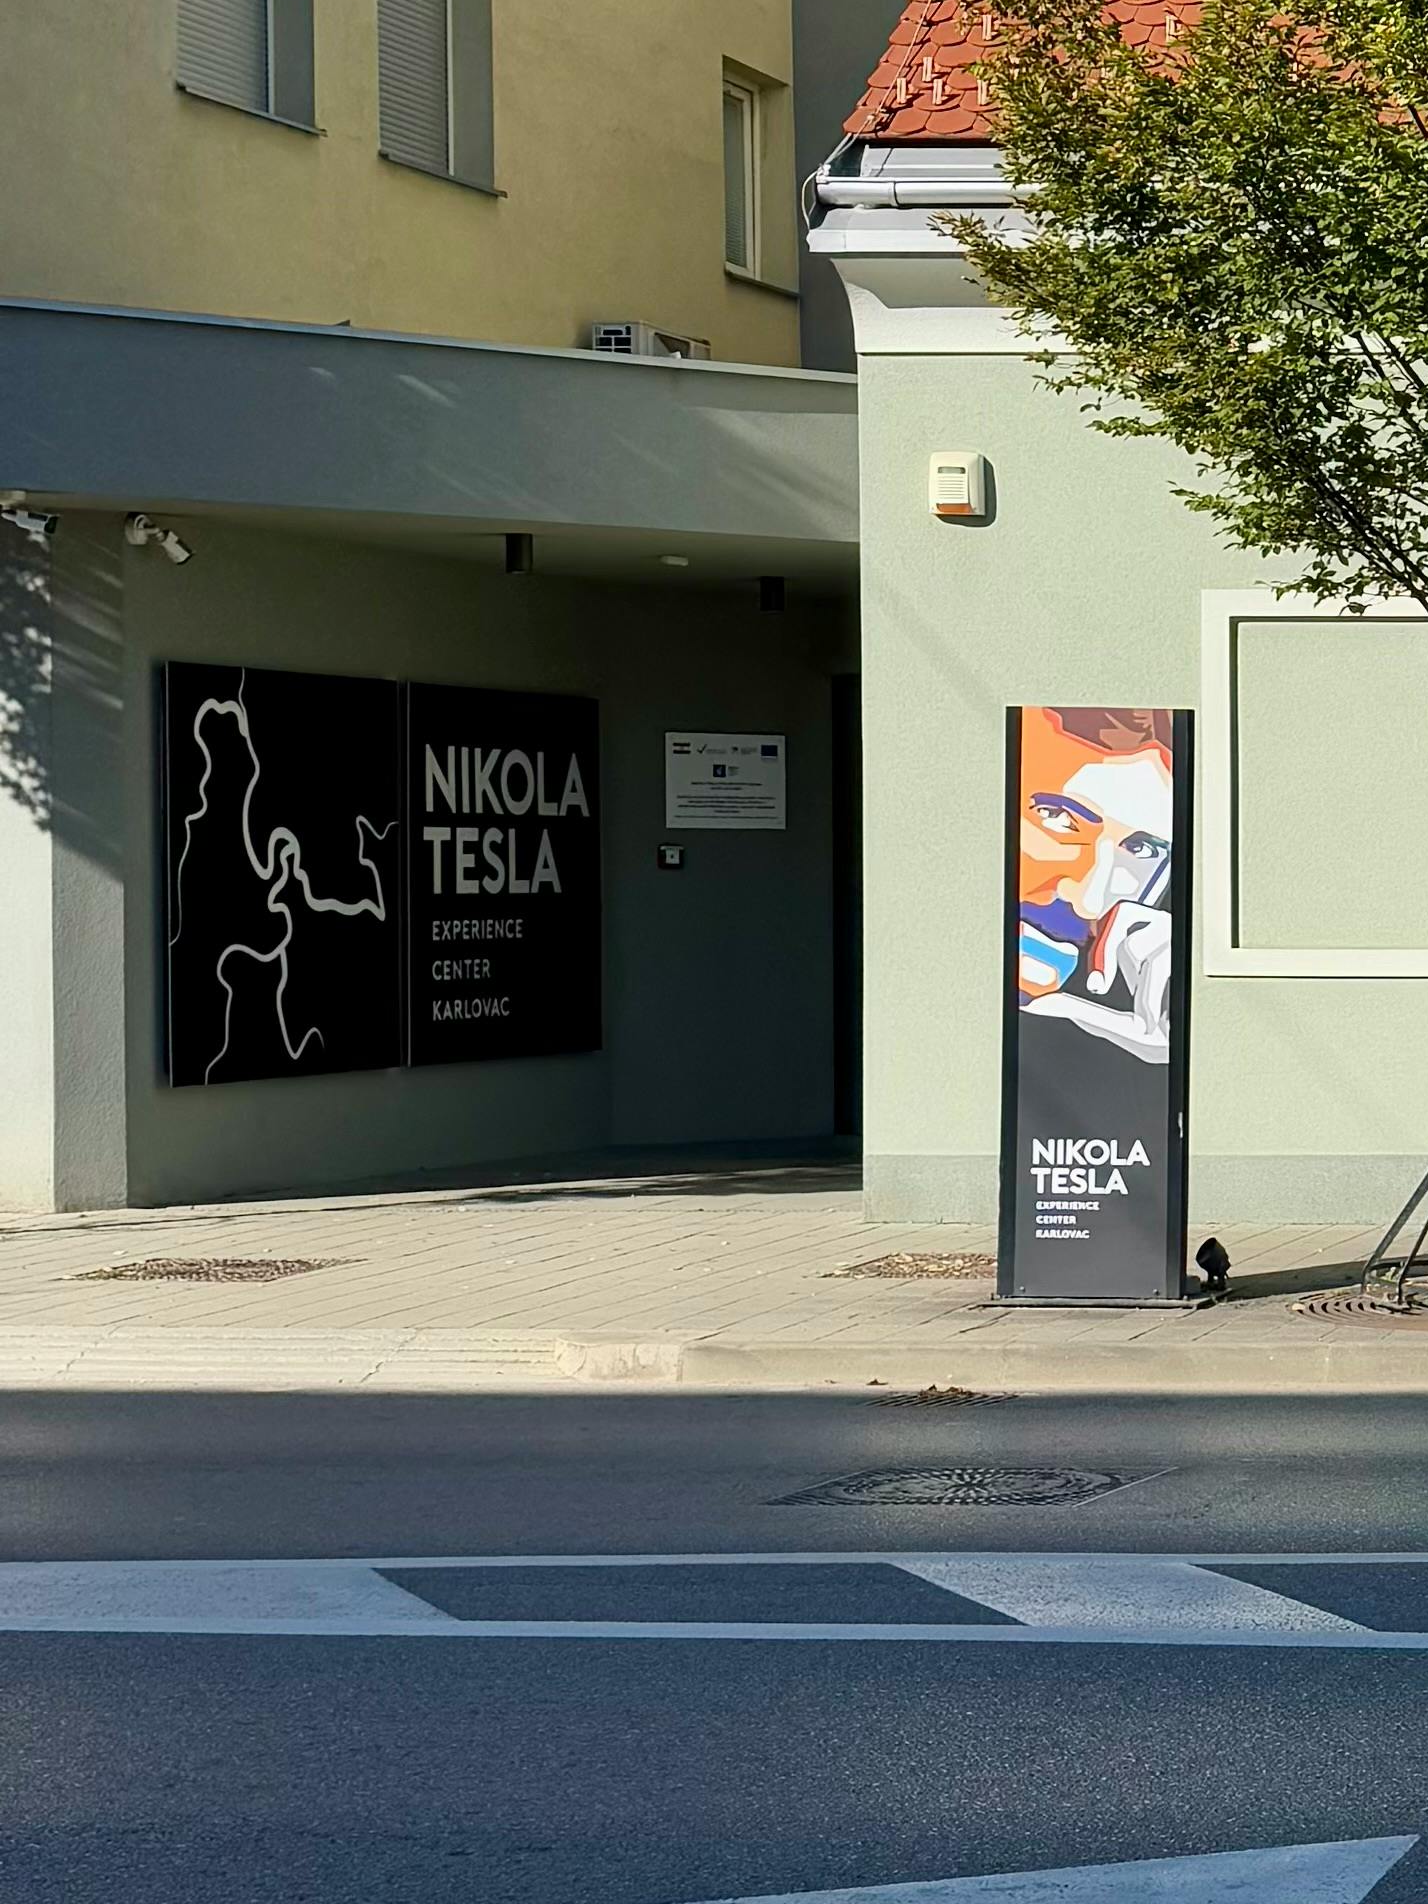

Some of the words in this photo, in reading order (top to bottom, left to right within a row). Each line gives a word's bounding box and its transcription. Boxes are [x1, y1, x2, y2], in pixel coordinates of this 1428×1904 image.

[425, 743, 589, 817] NIKOLA
[423, 826, 562, 895] TESLA
[431, 918, 524, 942] EXPERIENCE
[431, 958, 491, 981] CENTER
[432, 996, 511, 1022] KARLOVAC
[1031, 1138, 1151, 1167] NIKOLA
[1029, 1166, 1129, 1195] TESLA
[1035, 1200, 1101, 1211] EXPERIENCE
[1035, 1214, 1077, 1225] CENTER
[1035, 1229, 1090, 1239] KARLOVAC
